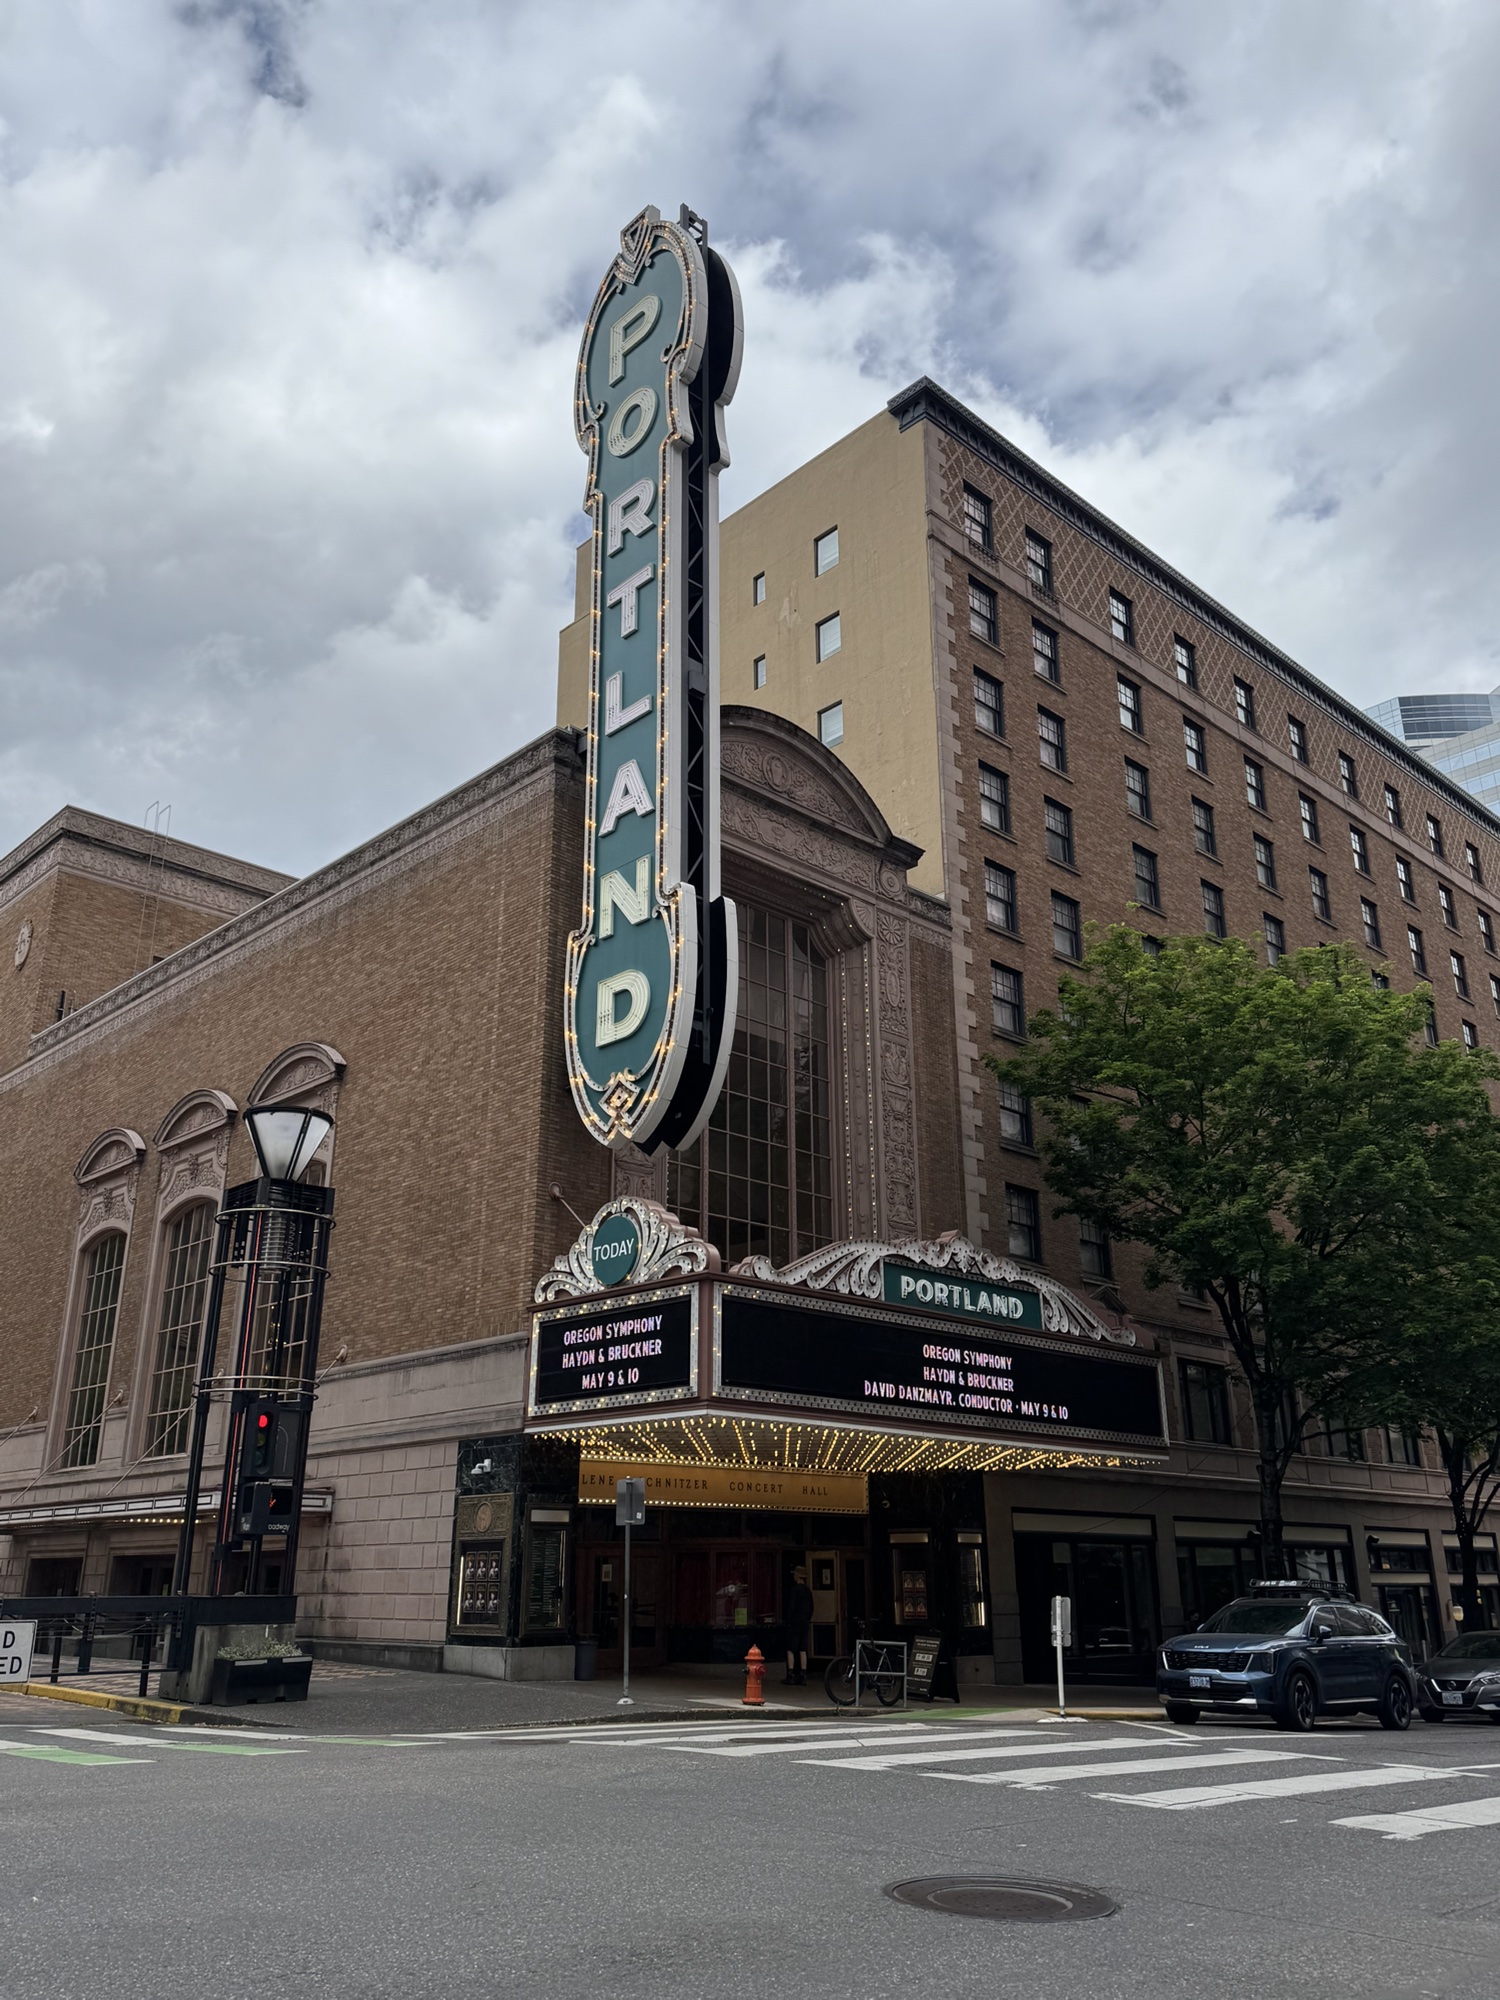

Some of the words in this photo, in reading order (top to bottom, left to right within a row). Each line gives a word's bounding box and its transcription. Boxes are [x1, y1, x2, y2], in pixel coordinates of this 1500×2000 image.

[595, 293, 661, 1048] PORTLAND
[593, 1238, 635, 1262] TODAY
[900, 1274, 1024, 1320] PORTLAND
[563, 1325, 603, 1346] OREGON
[605, 1314, 663, 1339] SYMPHONY
[562, 1349, 596, 1369] HAYDN
[598, 1348, 605, 1363] &
[608, 1339, 663, 1362] BRUCKNER
[922, 1344, 961, 1364] OREGON
[963, 1350, 1013, 1371] SYMPHONY
[581, 1371, 605, 1390] MAY
[607, 1371, 615, 1387] 9
[617, 1369, 625, 1385] &
[627, 1367, 640, 1384] 10
[923, 1366, 956, 1385] HAYDN
[958, 1371, 965, 1386] &
[967, 1373, 1014, 1392] BRUCKNER
[864, 1380, 896, 1399] DAVID
[958, 1393, 1013, 1414] CONDUCTOR
[1020, 1401, 1041, 1416] MAY
[1042, 1404, 1049, 1418] 9
[1050, 1406, 1057, 1419] &
[1058, 1406, 1069, 1421] 10
[639, 1477, 709, 1490] CHNITZER
[729, 1481, 783, 1494] CONCERT
[801, 1485, 829, 1496] HALL
